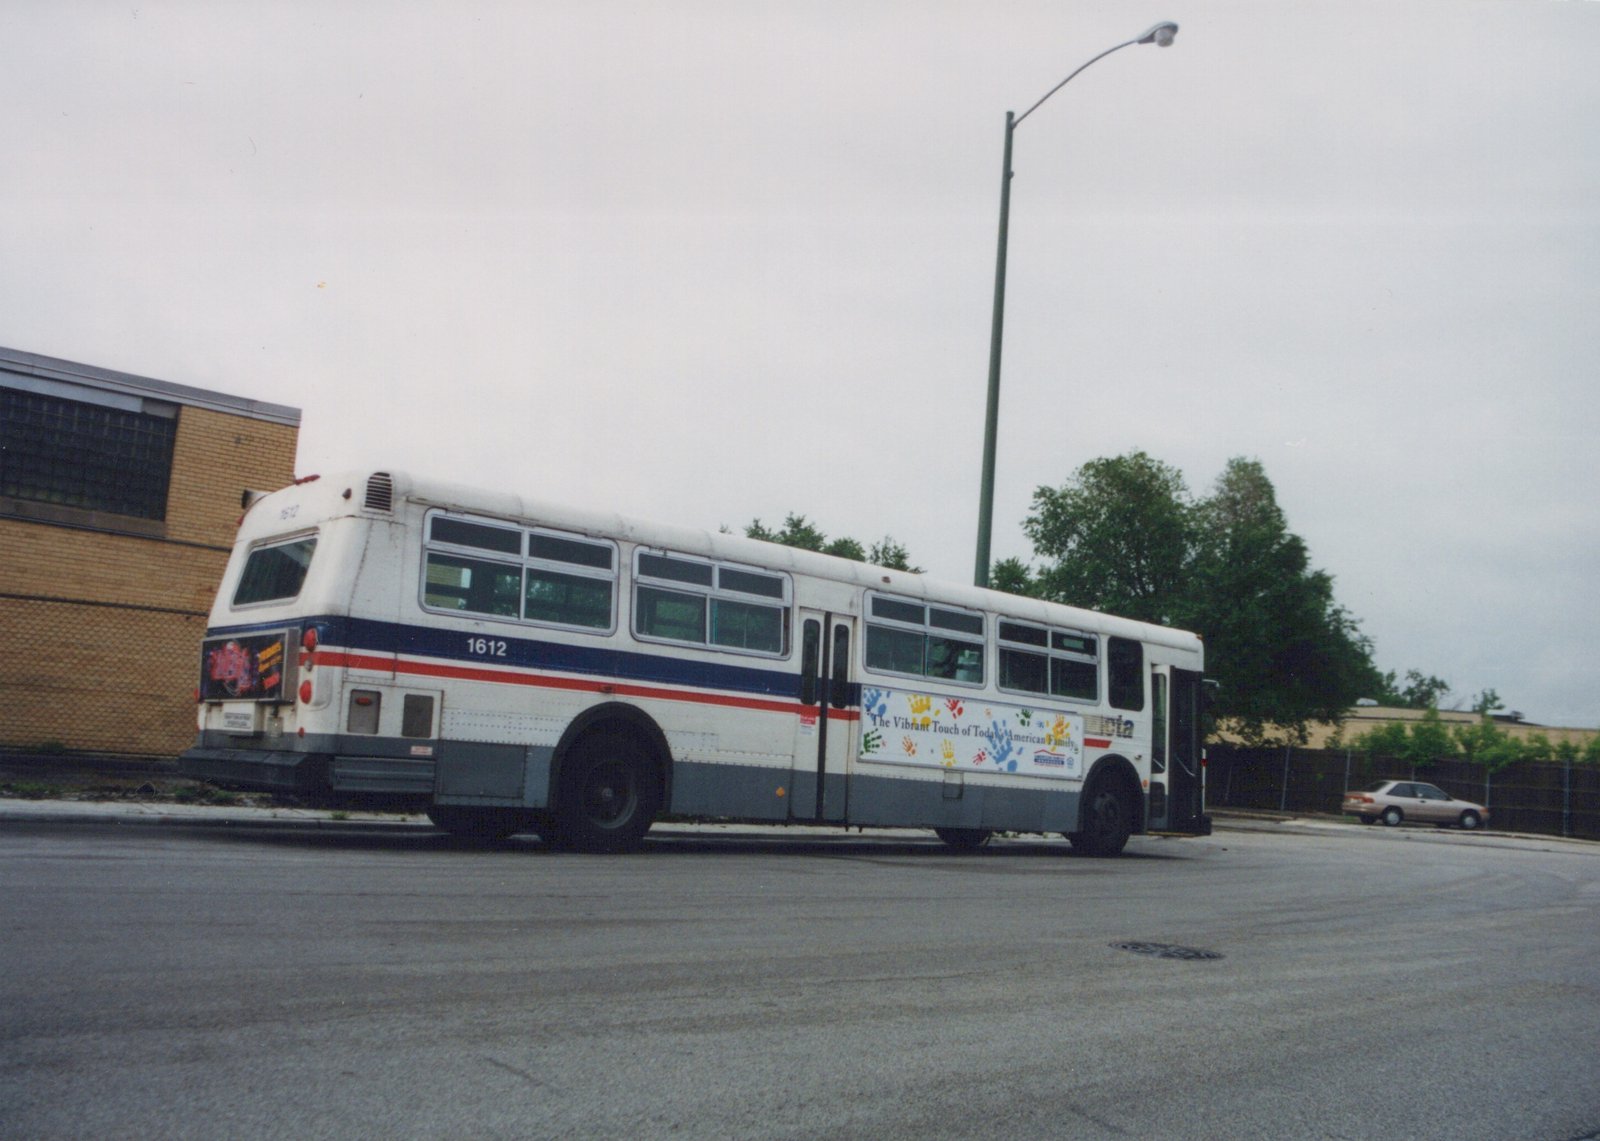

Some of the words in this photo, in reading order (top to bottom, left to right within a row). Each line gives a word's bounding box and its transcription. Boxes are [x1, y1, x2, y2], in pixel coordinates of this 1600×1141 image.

[467, 637, 507, 657] 1612
[871, 713, 891, 728] The
[893, 716, 930, 732] Vibrant
[932, 720, 960, 735] Touch
[961, 725, 972, 737] of
[1007, 728, 1046, 745] American
[1047, 733, 1076, 751] Family
